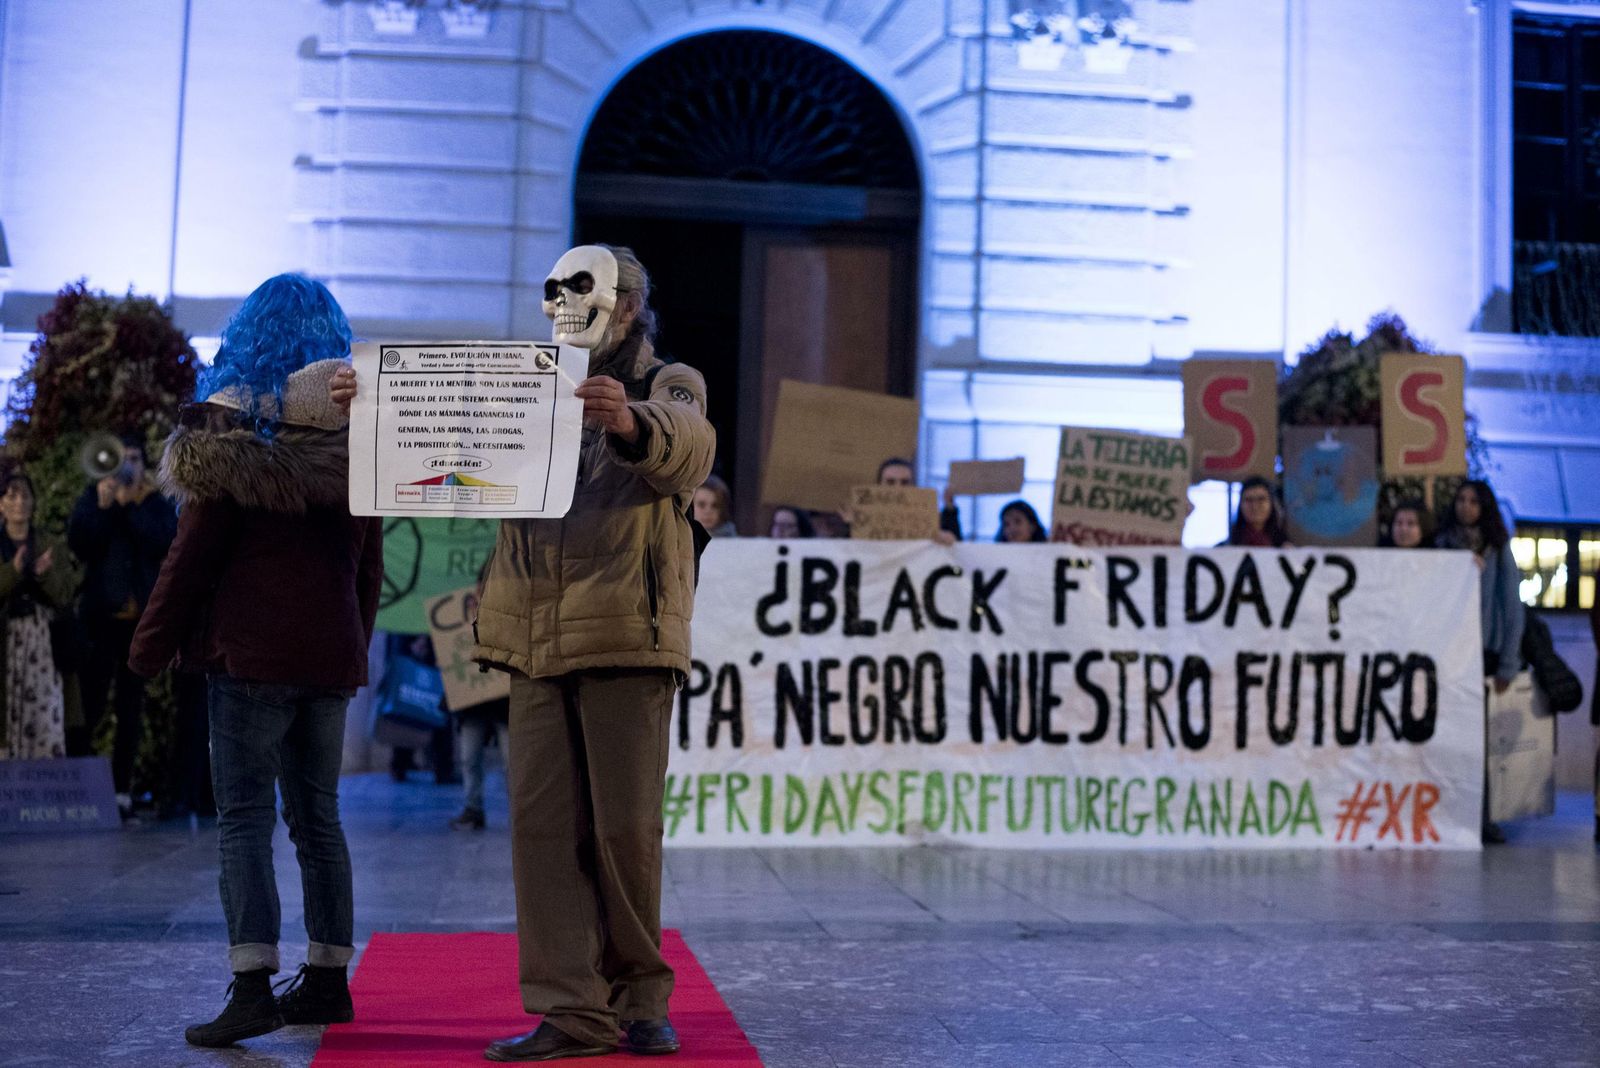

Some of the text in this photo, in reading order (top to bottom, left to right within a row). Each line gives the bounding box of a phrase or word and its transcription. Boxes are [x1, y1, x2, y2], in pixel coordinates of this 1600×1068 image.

[418, 351, 524, 360] Primero. EVOLUCIÓN HUMANA.
[389, 380, 399, 388] LA
[400, 380, 427, 388] MUERTE
[430, 380, 435, 388] Y
[436, 380, 445, 388] LA
[446, 380, 477, 388] MENTIRA
[479, 380, 494, 388] SON
[511, 381, 541, 389] MARCAS
[391, 395, 539, 405] OFICIALES DE ESTE SISTEMA CONSUMISTA.
[399, 408, 422, 417] DÓNDE
[438, 409, 471, 417] MÁXIMAS
[472, 410, 514, 418] GANANCIAS
[1202, 376, 1256, 470] S
[1400, 372, 1448, 464] S
[447, 427, 474, 435] ARMAS,
[492, 428, 524, 436] DROGAS,
[472, 443, 526, 451] NECESITAMOS:
[1061, 430, 1187, 470] LA TIERRA
[431, 460, 482, 468] ¡Educación!
[1059, 482, 1179, 522] LA ESTAMOS
[756, 545, 1356, 641] ¿BLACK FRIDAY?
[773, 650, 949, 750] NEGRO
[967, 649, 1213, 751] NUESTRO
[1236, 651, 1438, 750] FUTURO
[663, 769, 1441, 844] #FRIDAYSFORFUTUREGRANADA #XR
